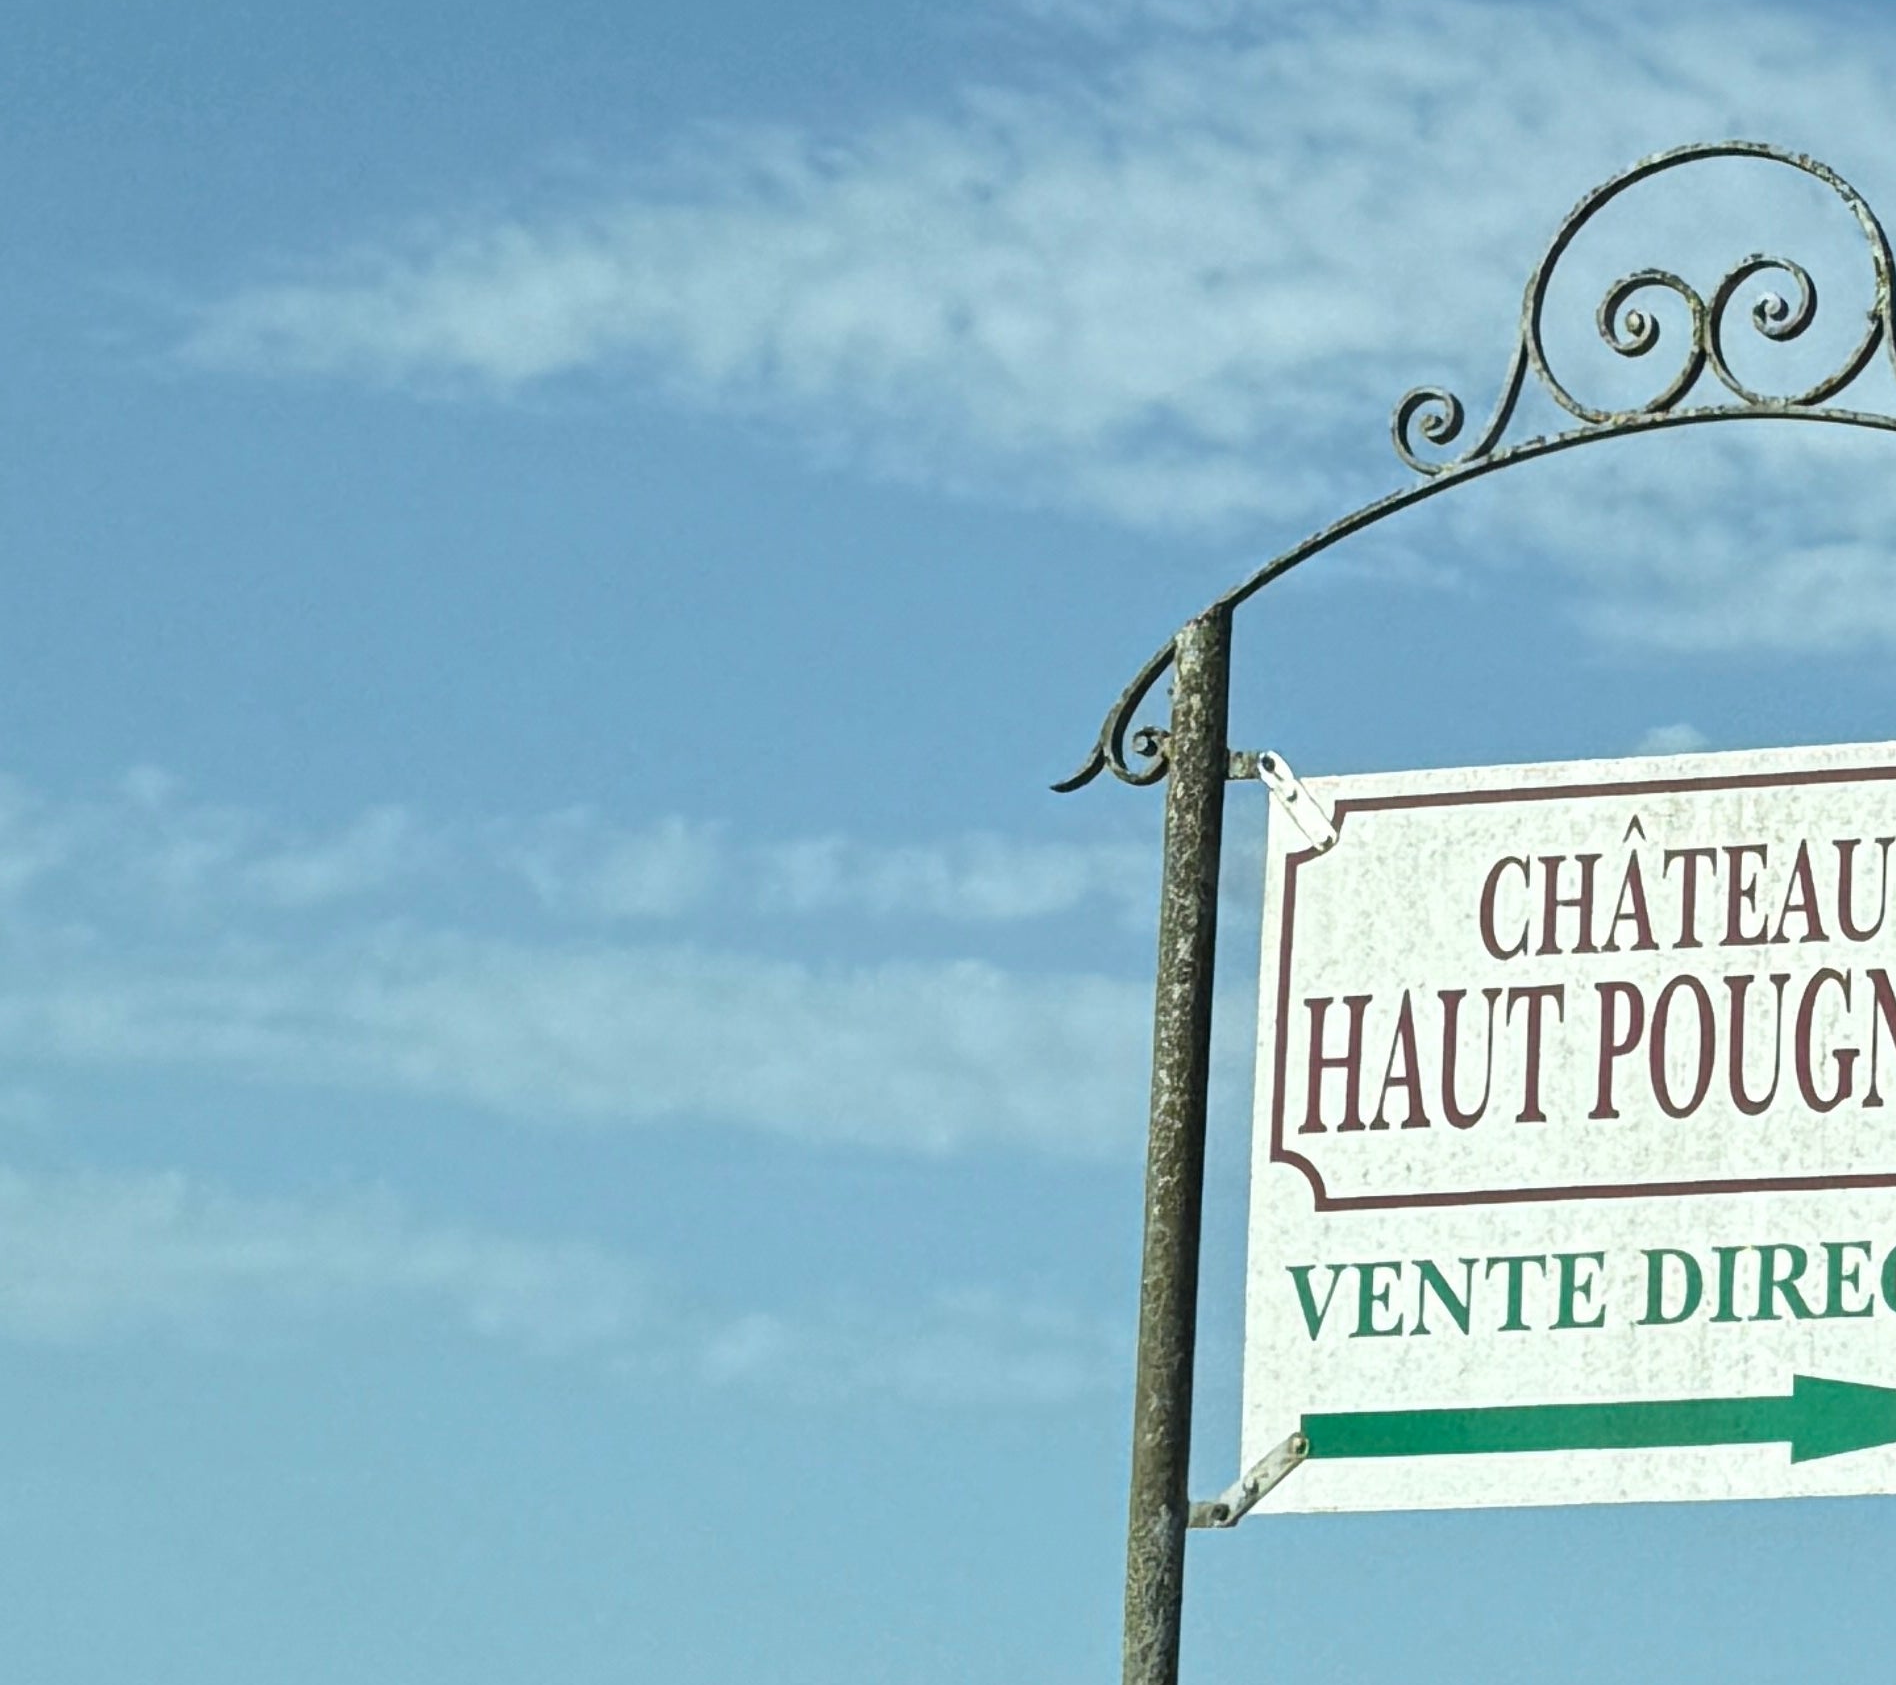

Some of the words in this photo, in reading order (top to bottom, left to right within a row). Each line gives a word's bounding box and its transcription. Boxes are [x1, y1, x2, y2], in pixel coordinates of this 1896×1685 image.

[1479, 814, 1896, 961] CHÂTEAU
[1298, 984, 1565, 1135] HAUT
[1285, 1250, 1606, 1342] VENTE
